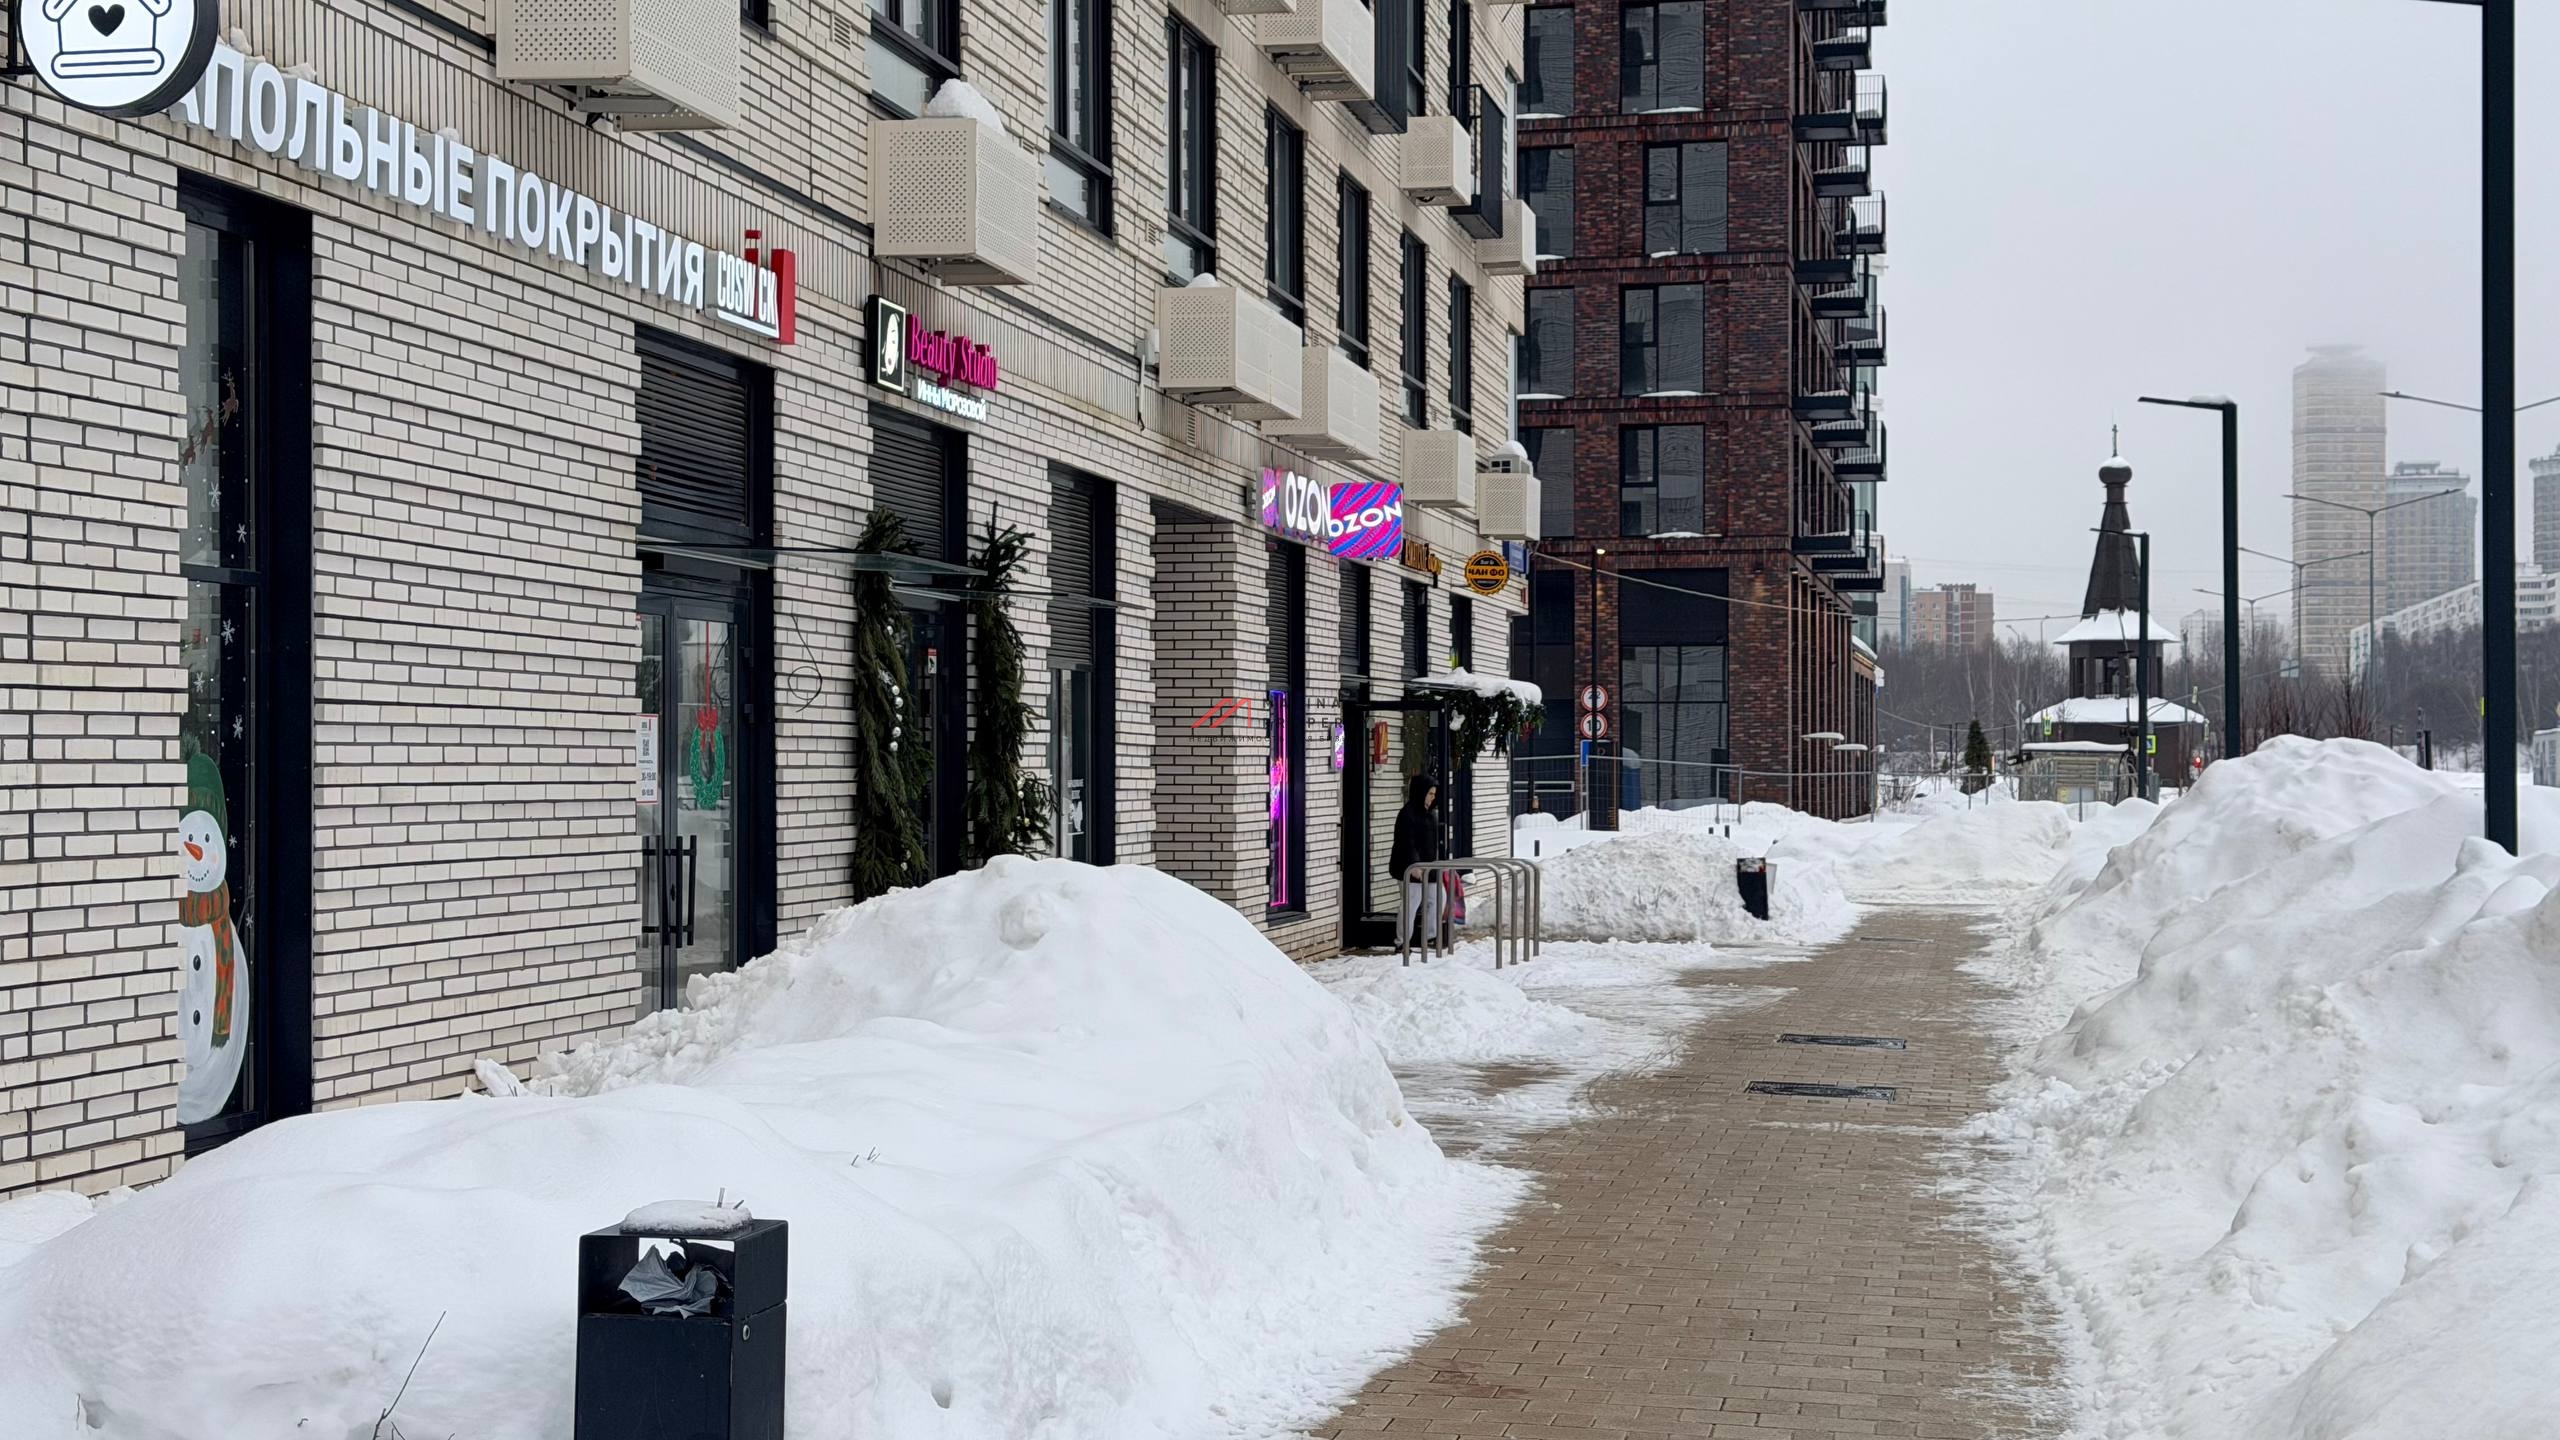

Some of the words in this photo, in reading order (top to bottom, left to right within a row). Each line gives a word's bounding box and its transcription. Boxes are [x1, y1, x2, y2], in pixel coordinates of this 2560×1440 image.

[487, 155, 704, 309] ПОКРЫТИЯ
[910, 313, 957, 387] Beauty
[960, 335, 998, 390] Studio
[1286, 471, 1331, 536] OZON
[1468, 568, 1488, 576] ЧАН
[1489, 568, 1505, 577] ФО
[1587, 720, 1602, 731] 10
